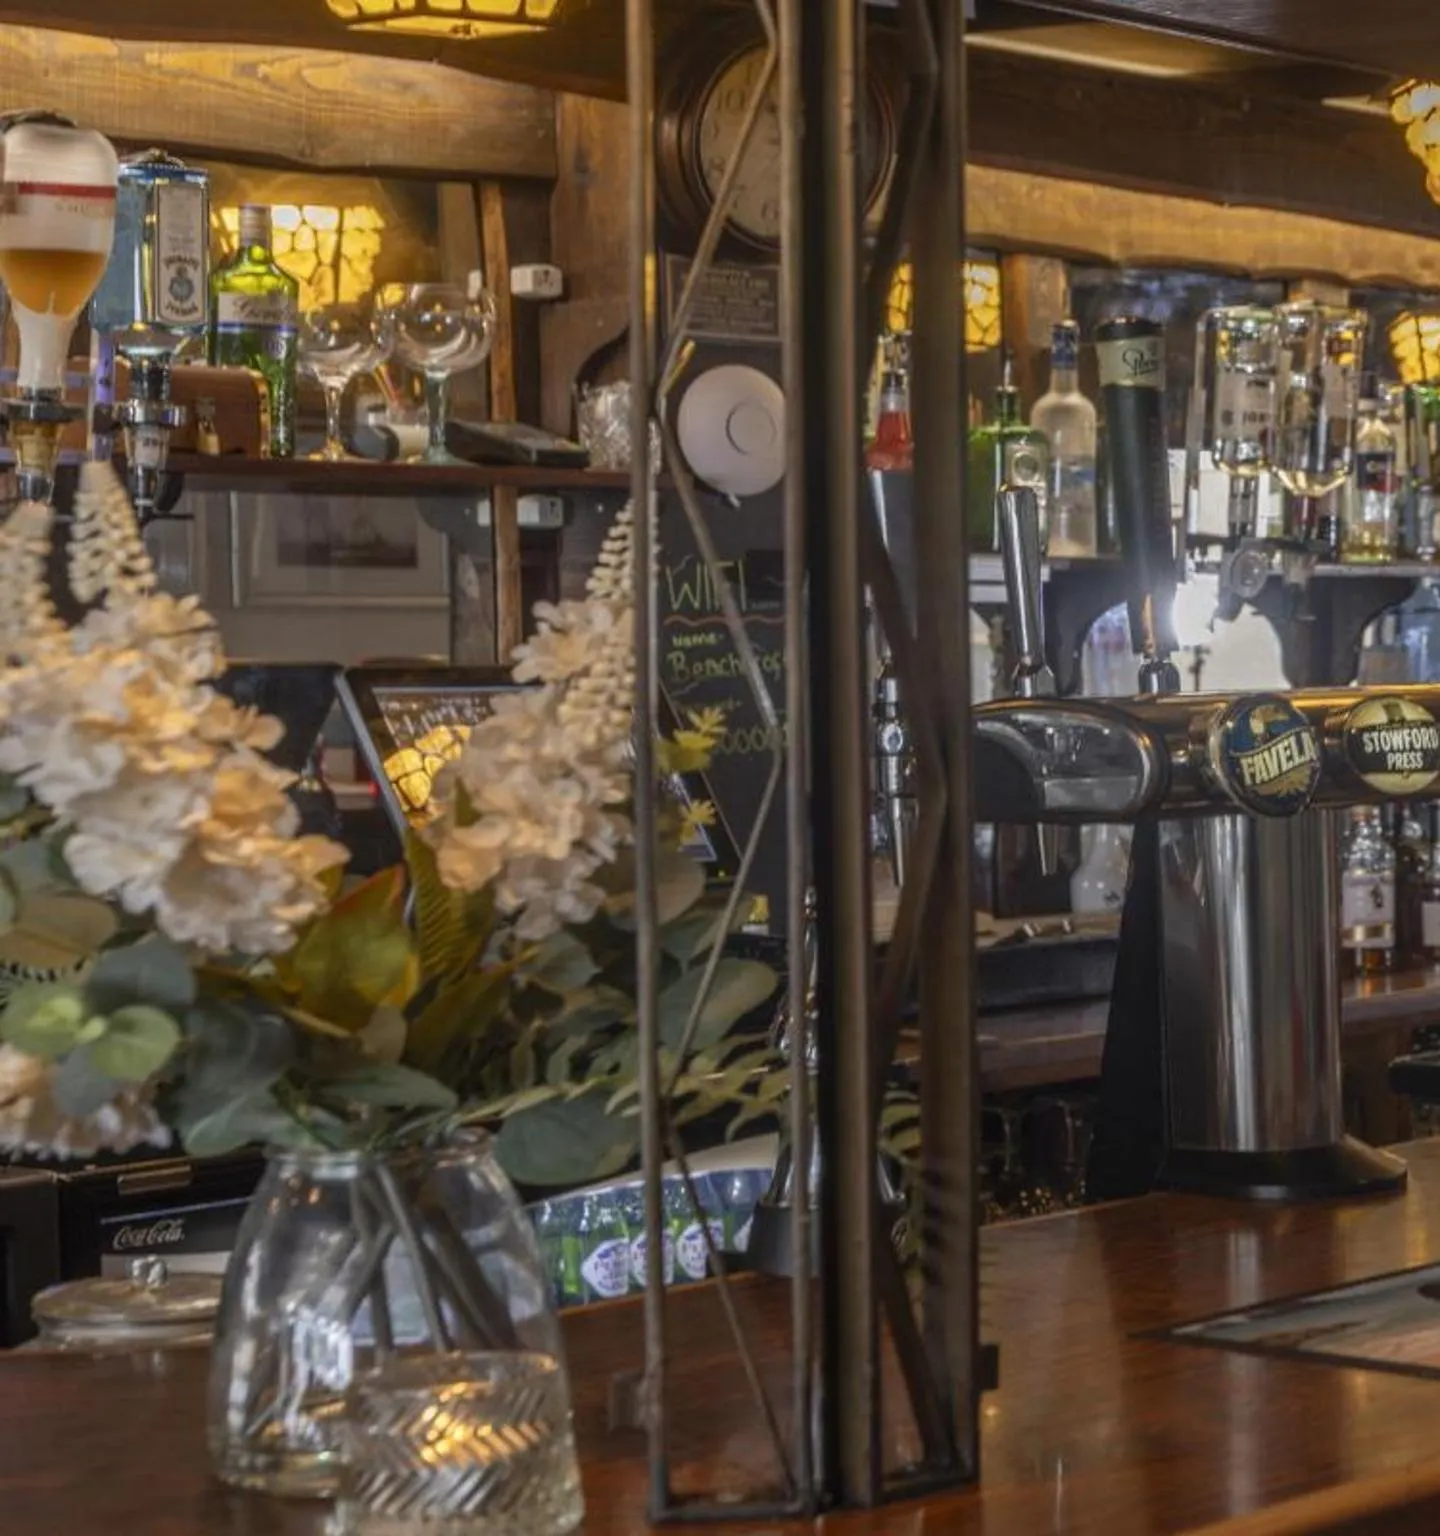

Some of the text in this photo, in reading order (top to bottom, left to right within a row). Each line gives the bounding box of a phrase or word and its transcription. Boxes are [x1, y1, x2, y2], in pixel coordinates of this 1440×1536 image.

[1362, 726, 1439, 754] STOWFORD
[1240, 731, 1319, 786] FAVELA
[1386, 751, 1425, 771] PRESS
